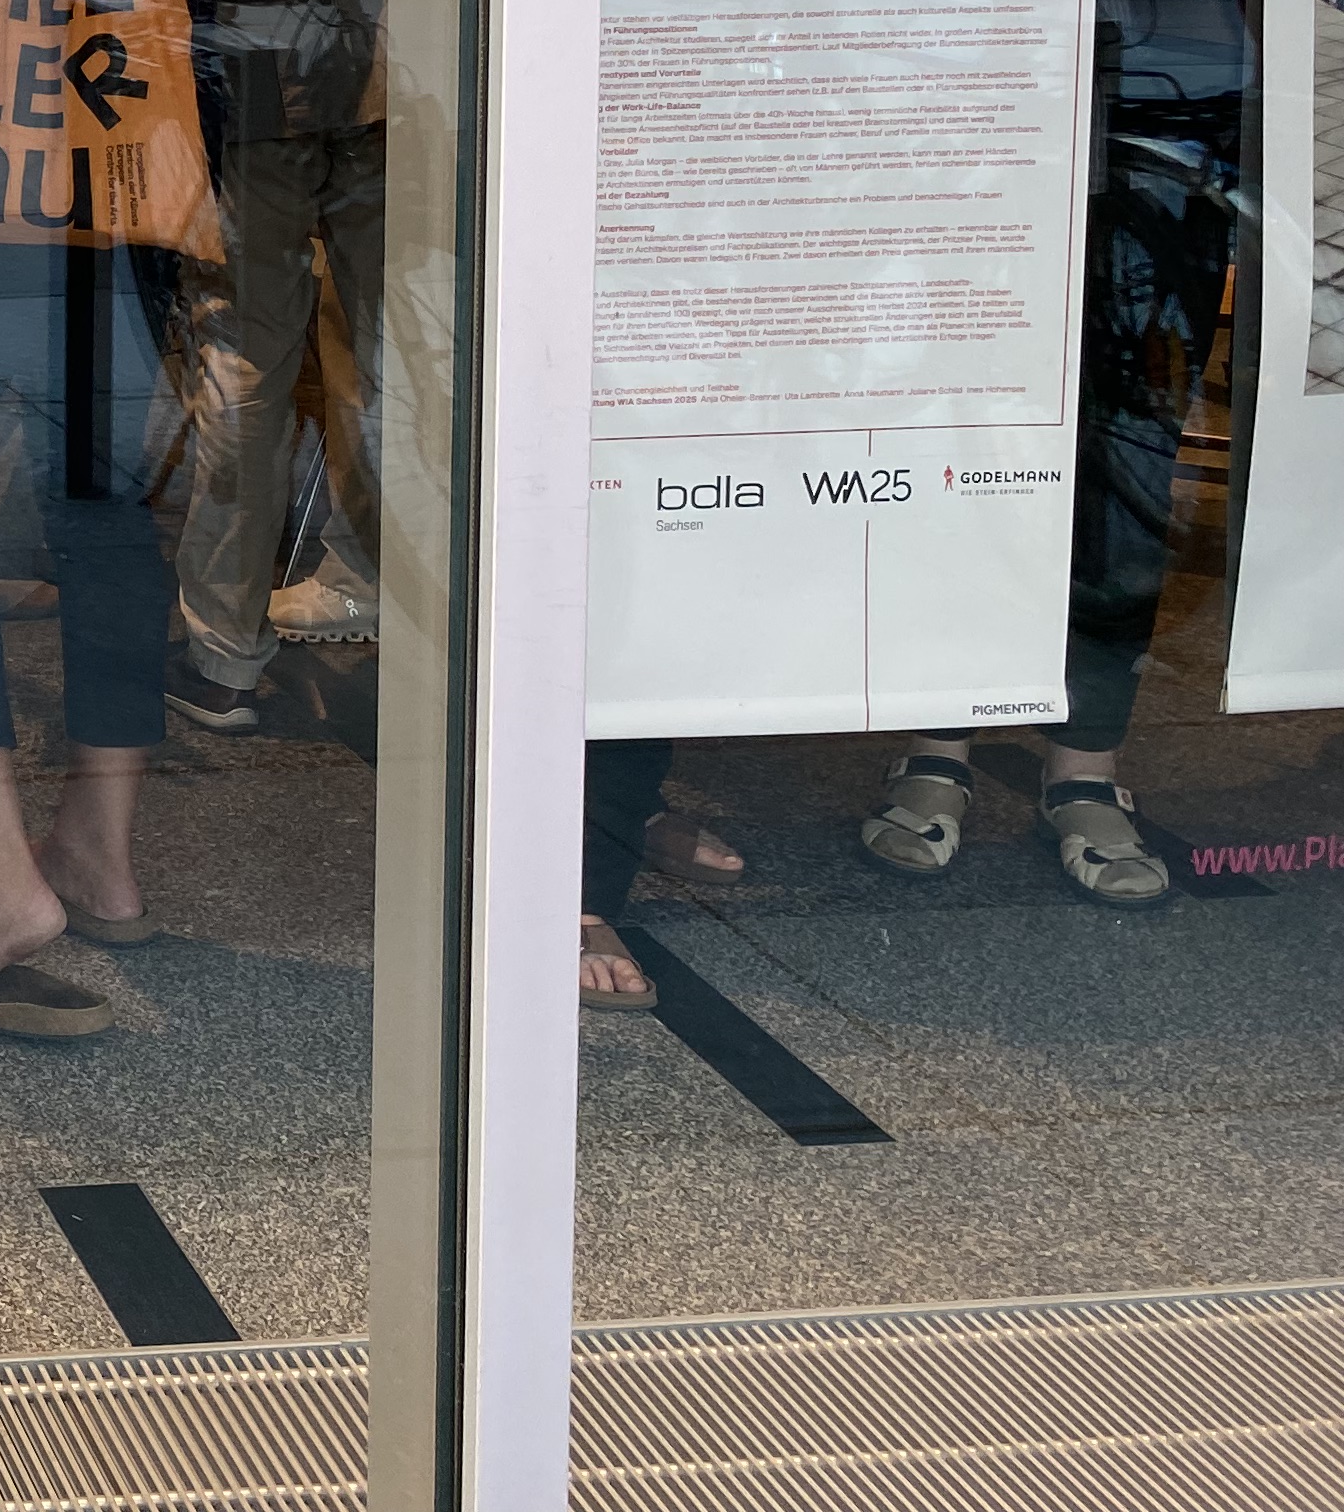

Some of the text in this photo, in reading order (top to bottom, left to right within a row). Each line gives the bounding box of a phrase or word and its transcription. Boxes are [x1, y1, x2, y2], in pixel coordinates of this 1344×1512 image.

[961, 471, 1061, 483] GODELMANN
[656, 476, 764, 510] bdla
[656, 520, 703, 532] Sachsen
[971, 701, 1056, 717] PIGMENTPOL
